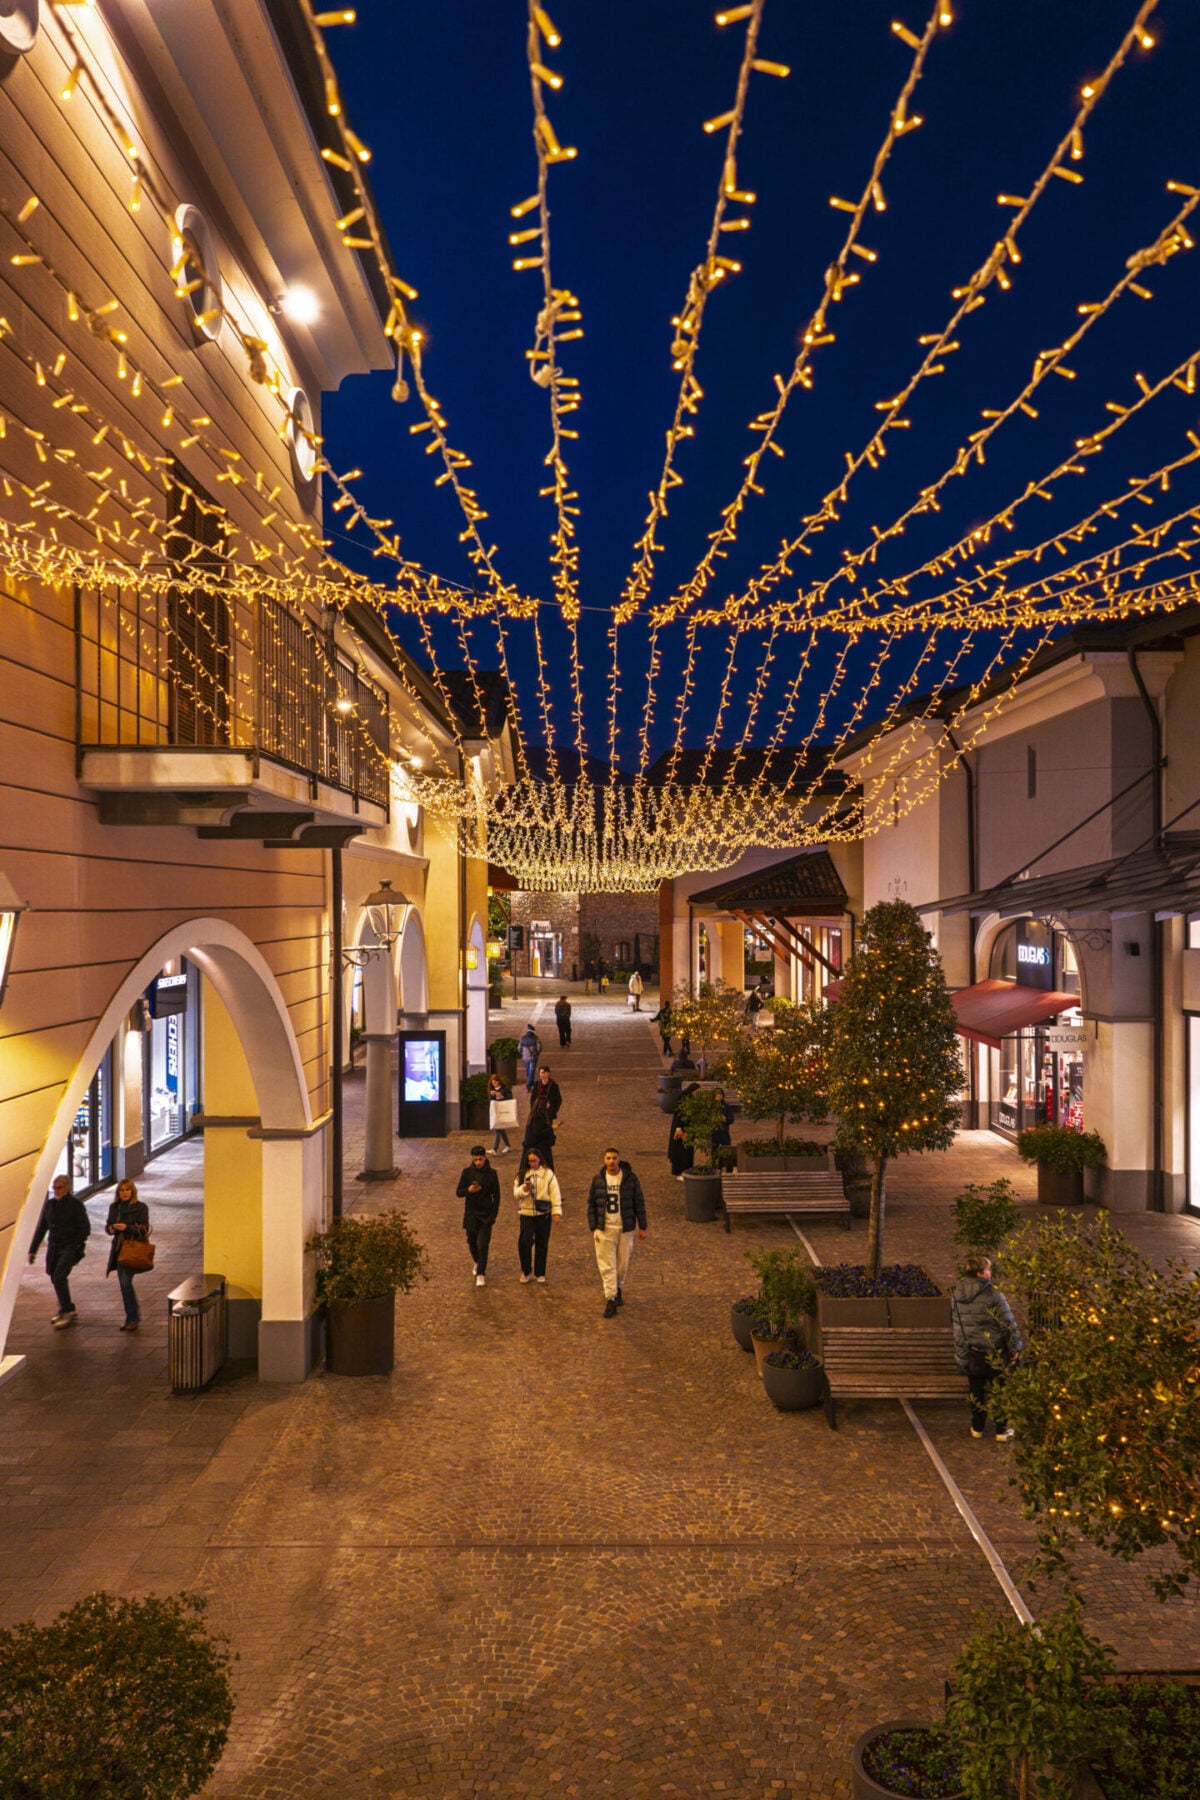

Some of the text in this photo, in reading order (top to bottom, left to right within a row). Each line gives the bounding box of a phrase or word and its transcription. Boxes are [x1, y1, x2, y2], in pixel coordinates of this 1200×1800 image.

[1018, 945, 1047, 965] DOUGLAS
[157, 974, 187, 989] SKECHERS
[168, 1014, 178, 1077] ECHERS
[1051, 1034, 1087, 1043] DOUGLAS
